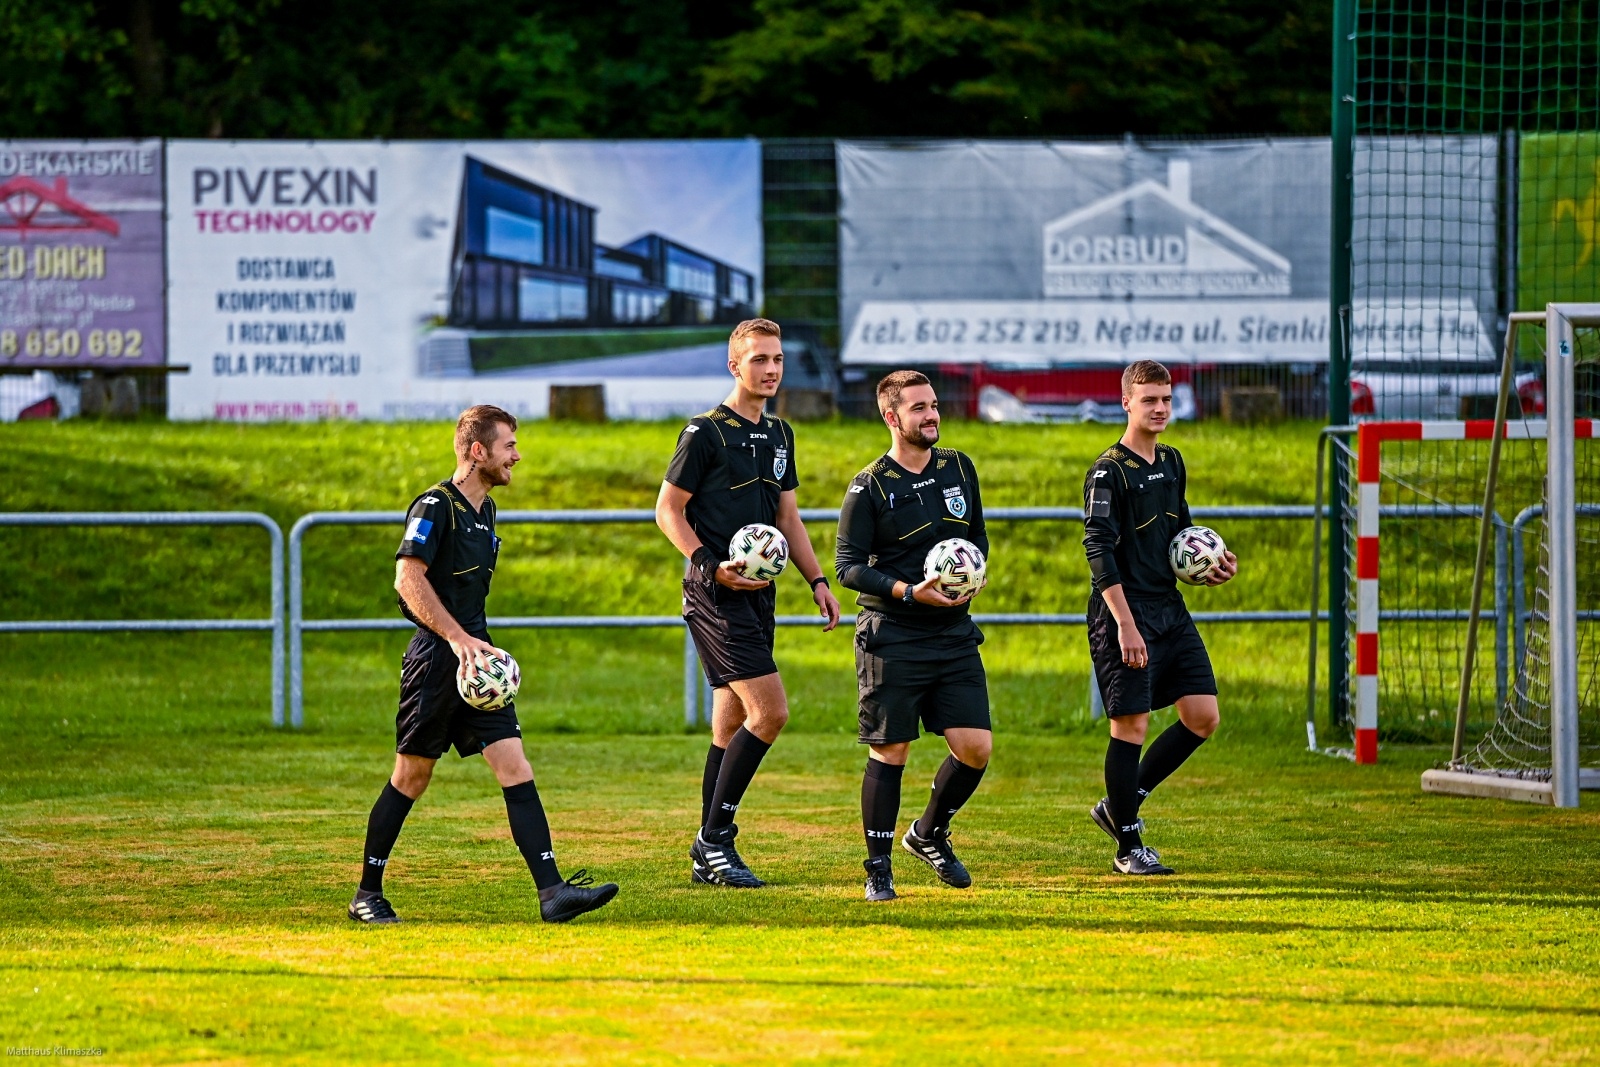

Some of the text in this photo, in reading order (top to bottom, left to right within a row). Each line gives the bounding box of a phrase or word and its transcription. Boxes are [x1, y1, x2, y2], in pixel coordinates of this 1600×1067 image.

[0, 150, 154, 177] DEKARSKIE
[192, 168, 378, 206] PIVEXIN
[194, 210, 376, 234] TECHNOLOGY
[1046, 235, 1185, 264] DORBUD
[237, 257, 336, 281] DOSTAWCA
[216, 289, 357, 313] KOMPONENTÓW
[0, 328, 143, 359] 8 650 692
[239, 319, 347, 348] ROZWIĄZAŃ
[861, 319, 905, 344] tel.
[915, 319, 968, 343] 602
[974, 319, 1026, 343] 252
[1191, 317, 1228, 343] ul.
[213, 353, 362, 377] DLA PRZEMYSŁU
